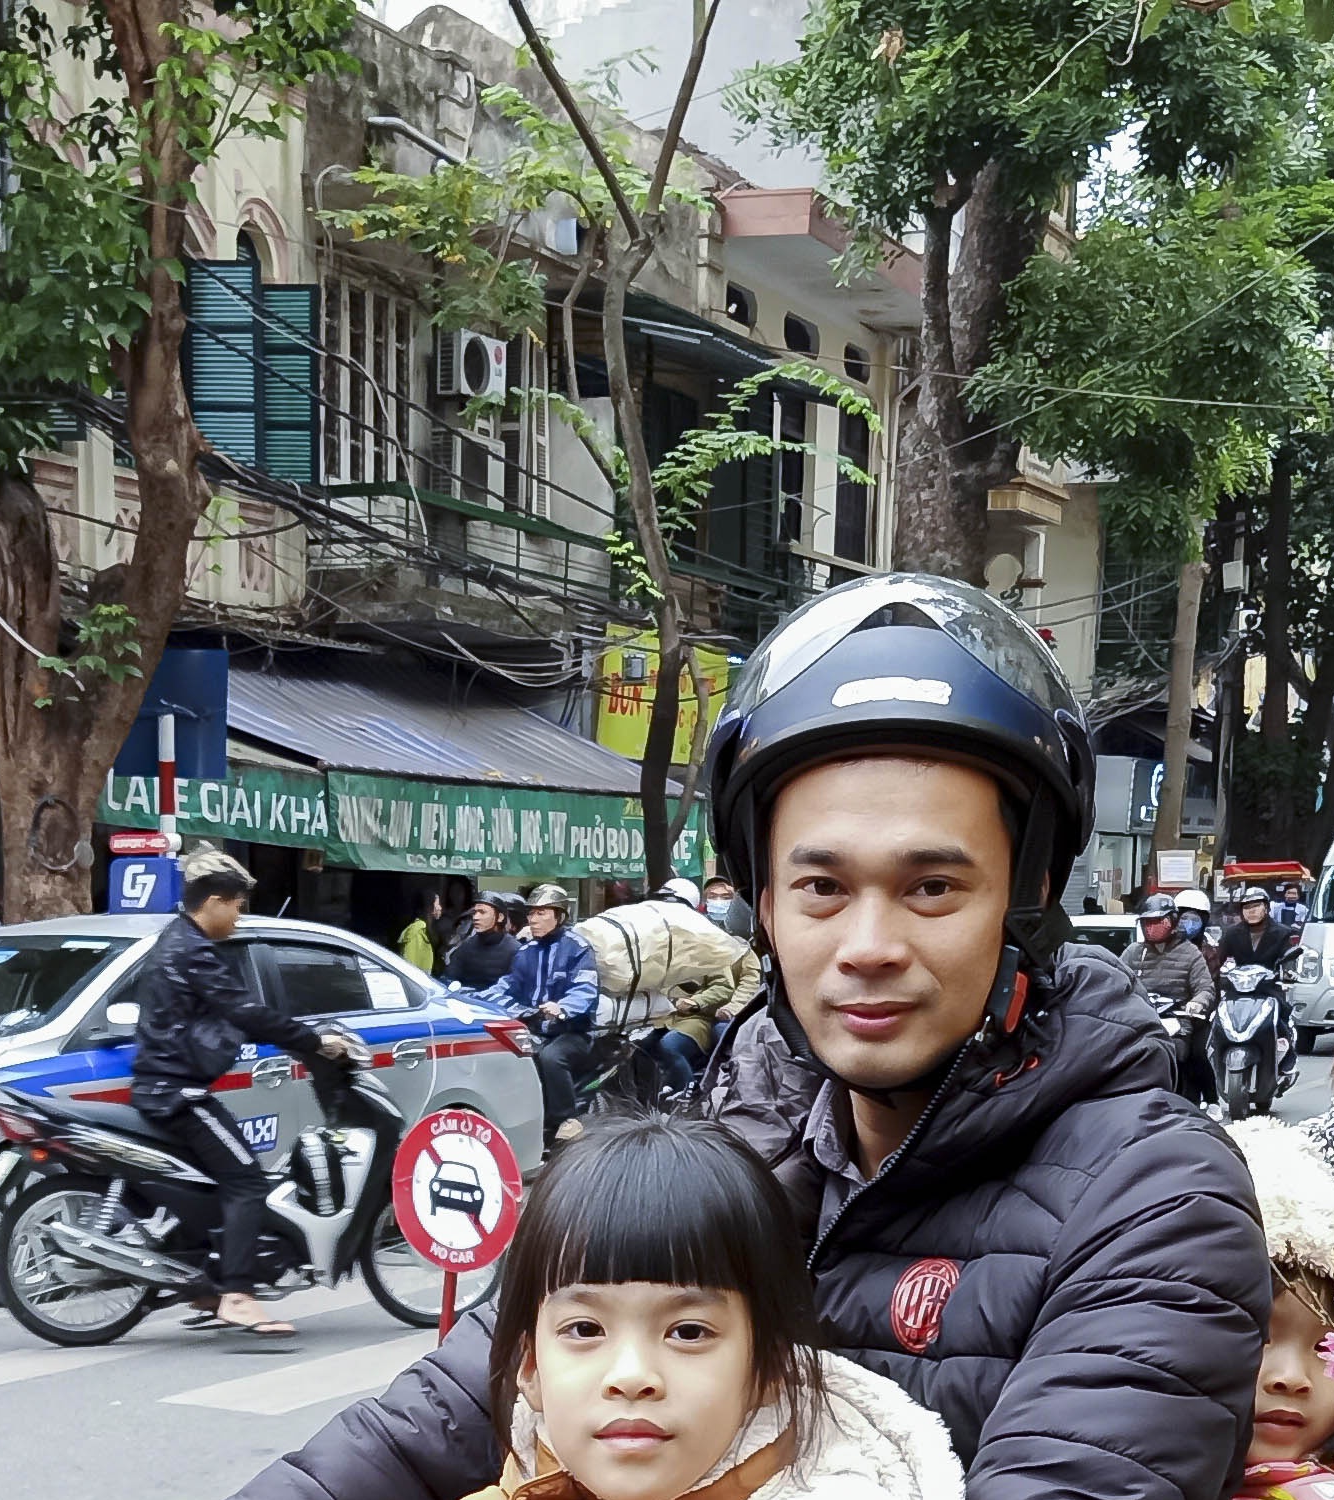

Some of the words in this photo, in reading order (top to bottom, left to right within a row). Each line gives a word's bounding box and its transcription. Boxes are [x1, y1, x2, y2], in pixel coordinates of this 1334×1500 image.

[122, 864, 156, 908] G7
[236, 1117, 278, 1144] AXI
[430, 1242, 448, 1260] NO
[448, 1250, 476, 1264] CAR
